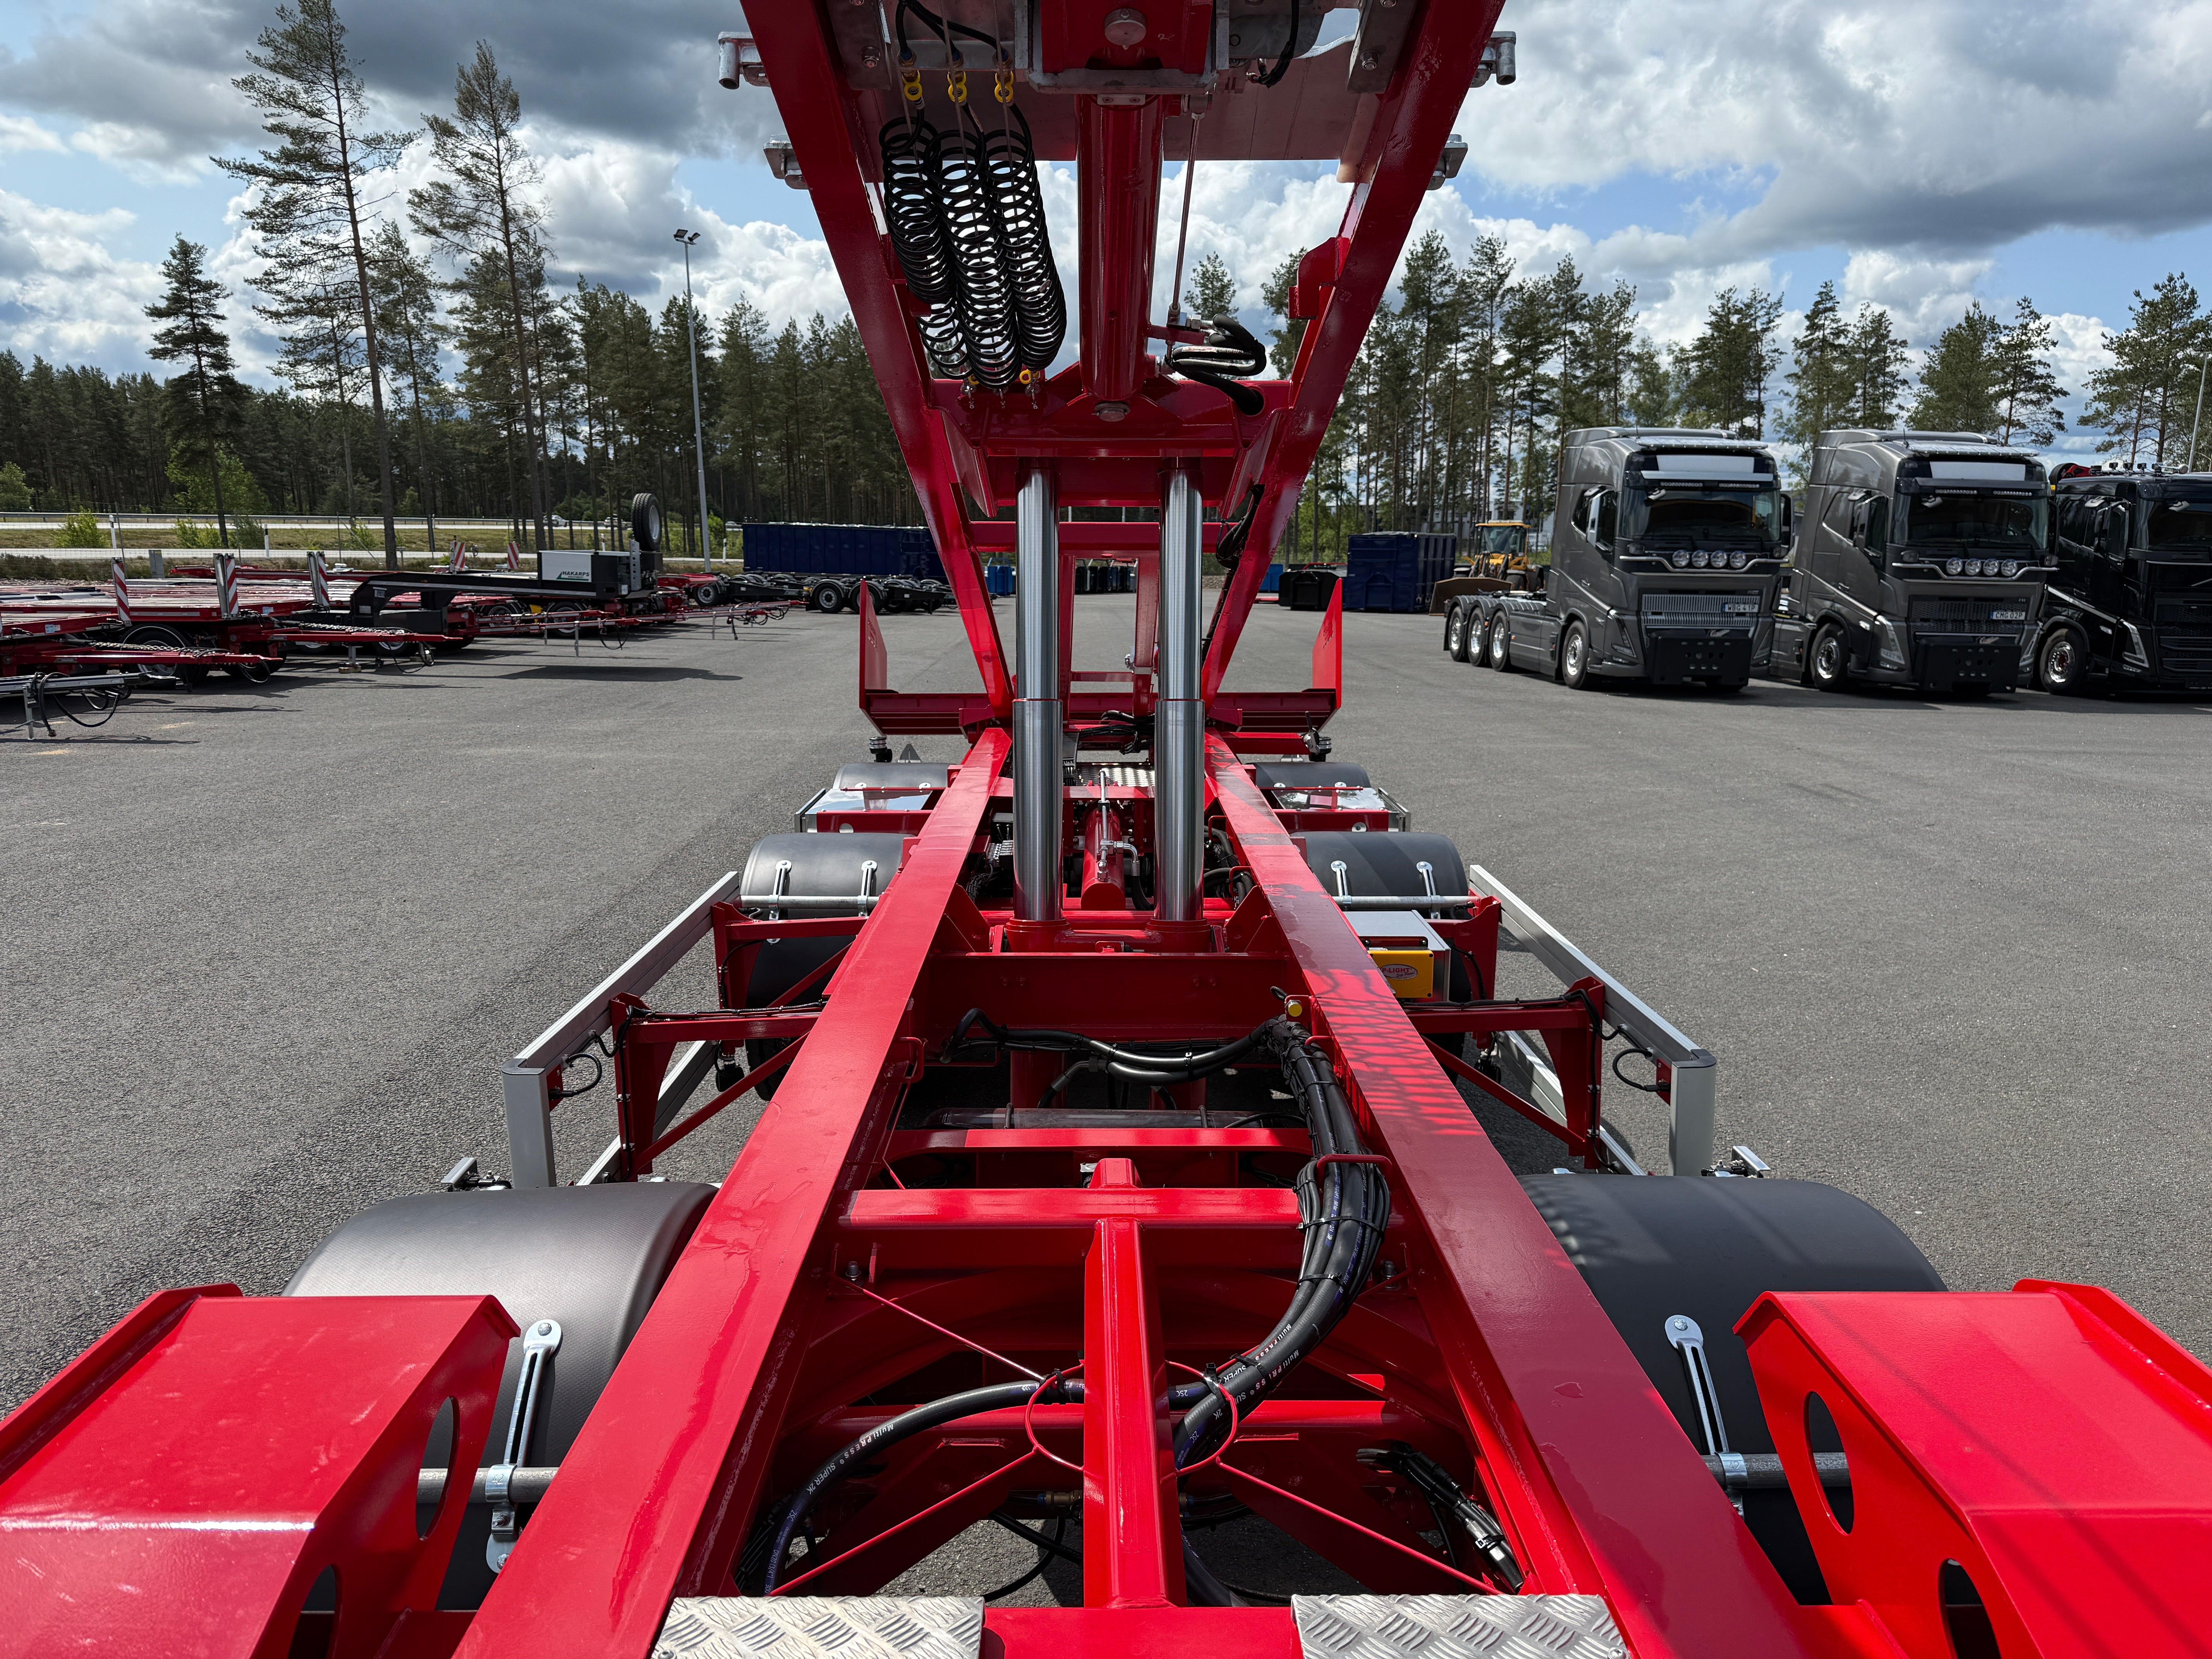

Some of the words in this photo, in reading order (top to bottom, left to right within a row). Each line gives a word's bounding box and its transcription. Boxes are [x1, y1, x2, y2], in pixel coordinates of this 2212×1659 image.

[1190, 1431, 1199, 1443] 2SC
[1729, 1460, 1741, 1470] 42
[814, 1463, 836, 1486] SUPER
[806, 1483, 816, 1495] 2K
[787, 1510, 797, 1522] 2SC
[770, 1549, 779, 1563] DN20
